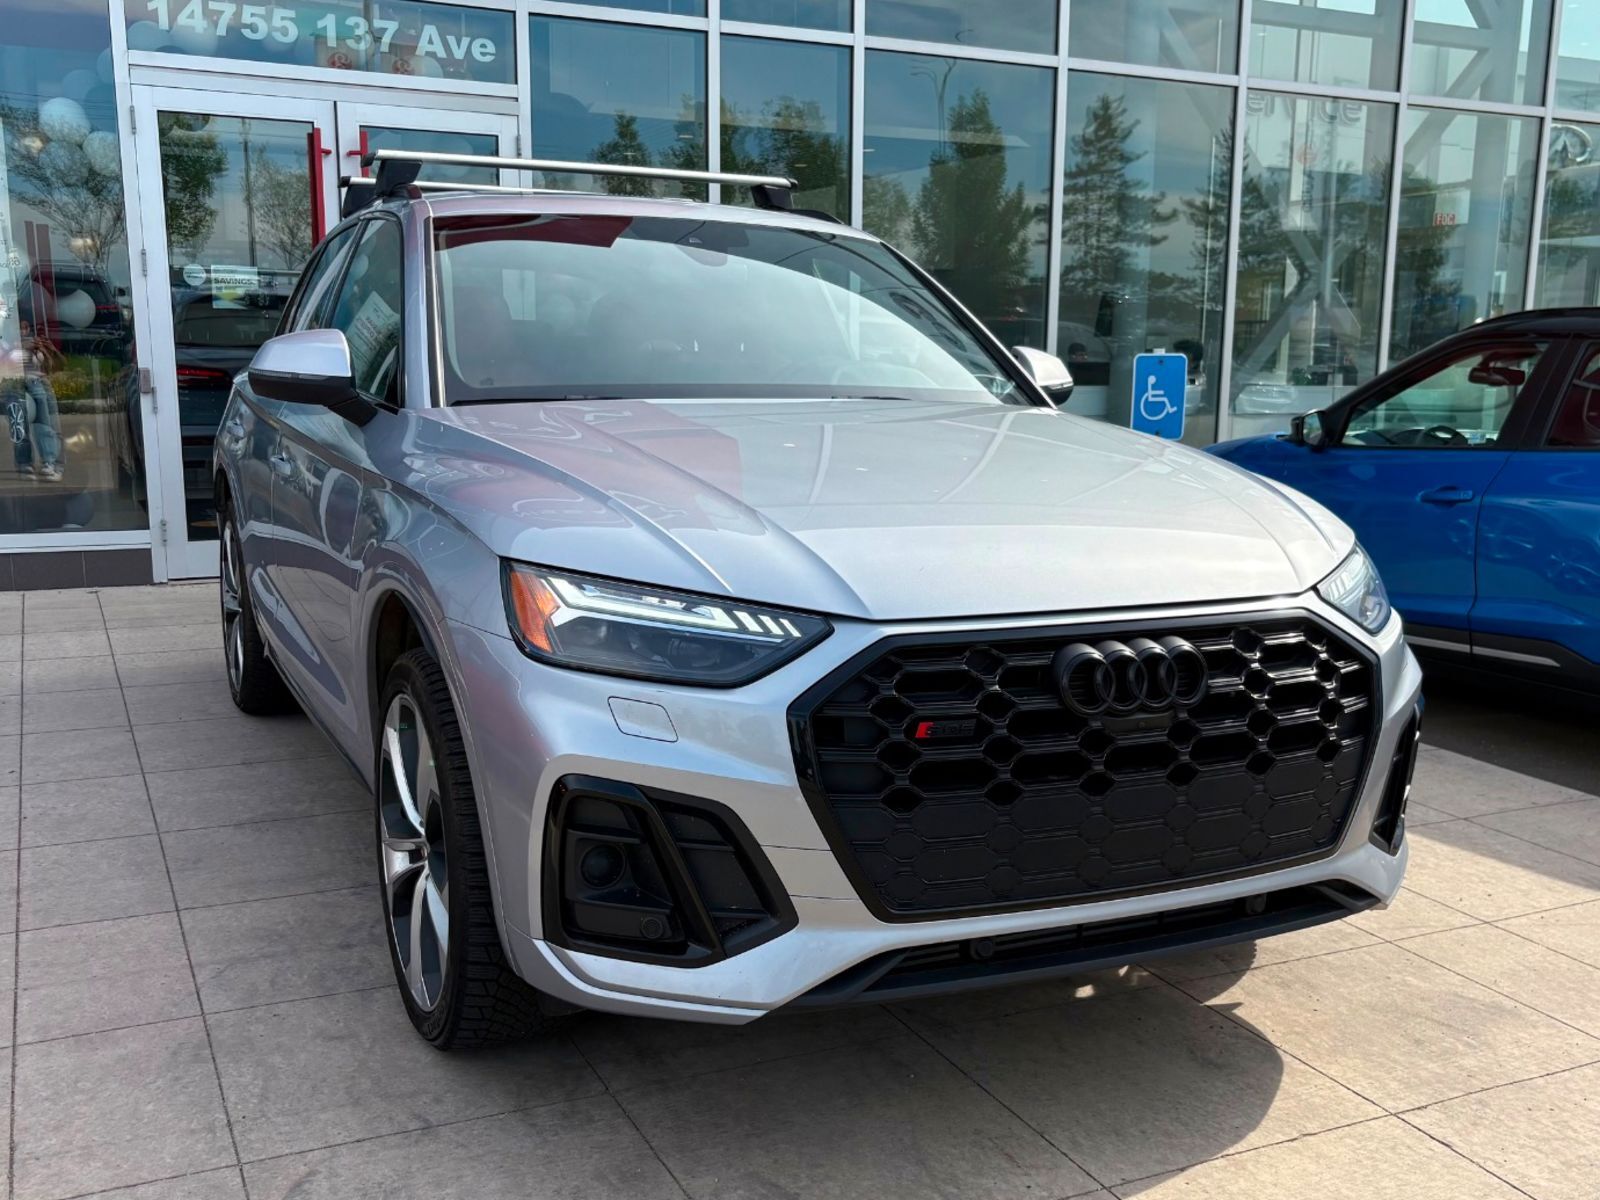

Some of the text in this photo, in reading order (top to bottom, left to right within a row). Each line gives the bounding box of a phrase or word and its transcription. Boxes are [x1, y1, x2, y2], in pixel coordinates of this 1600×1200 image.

[147, 0, 496, 62] 14755 137 Ave
